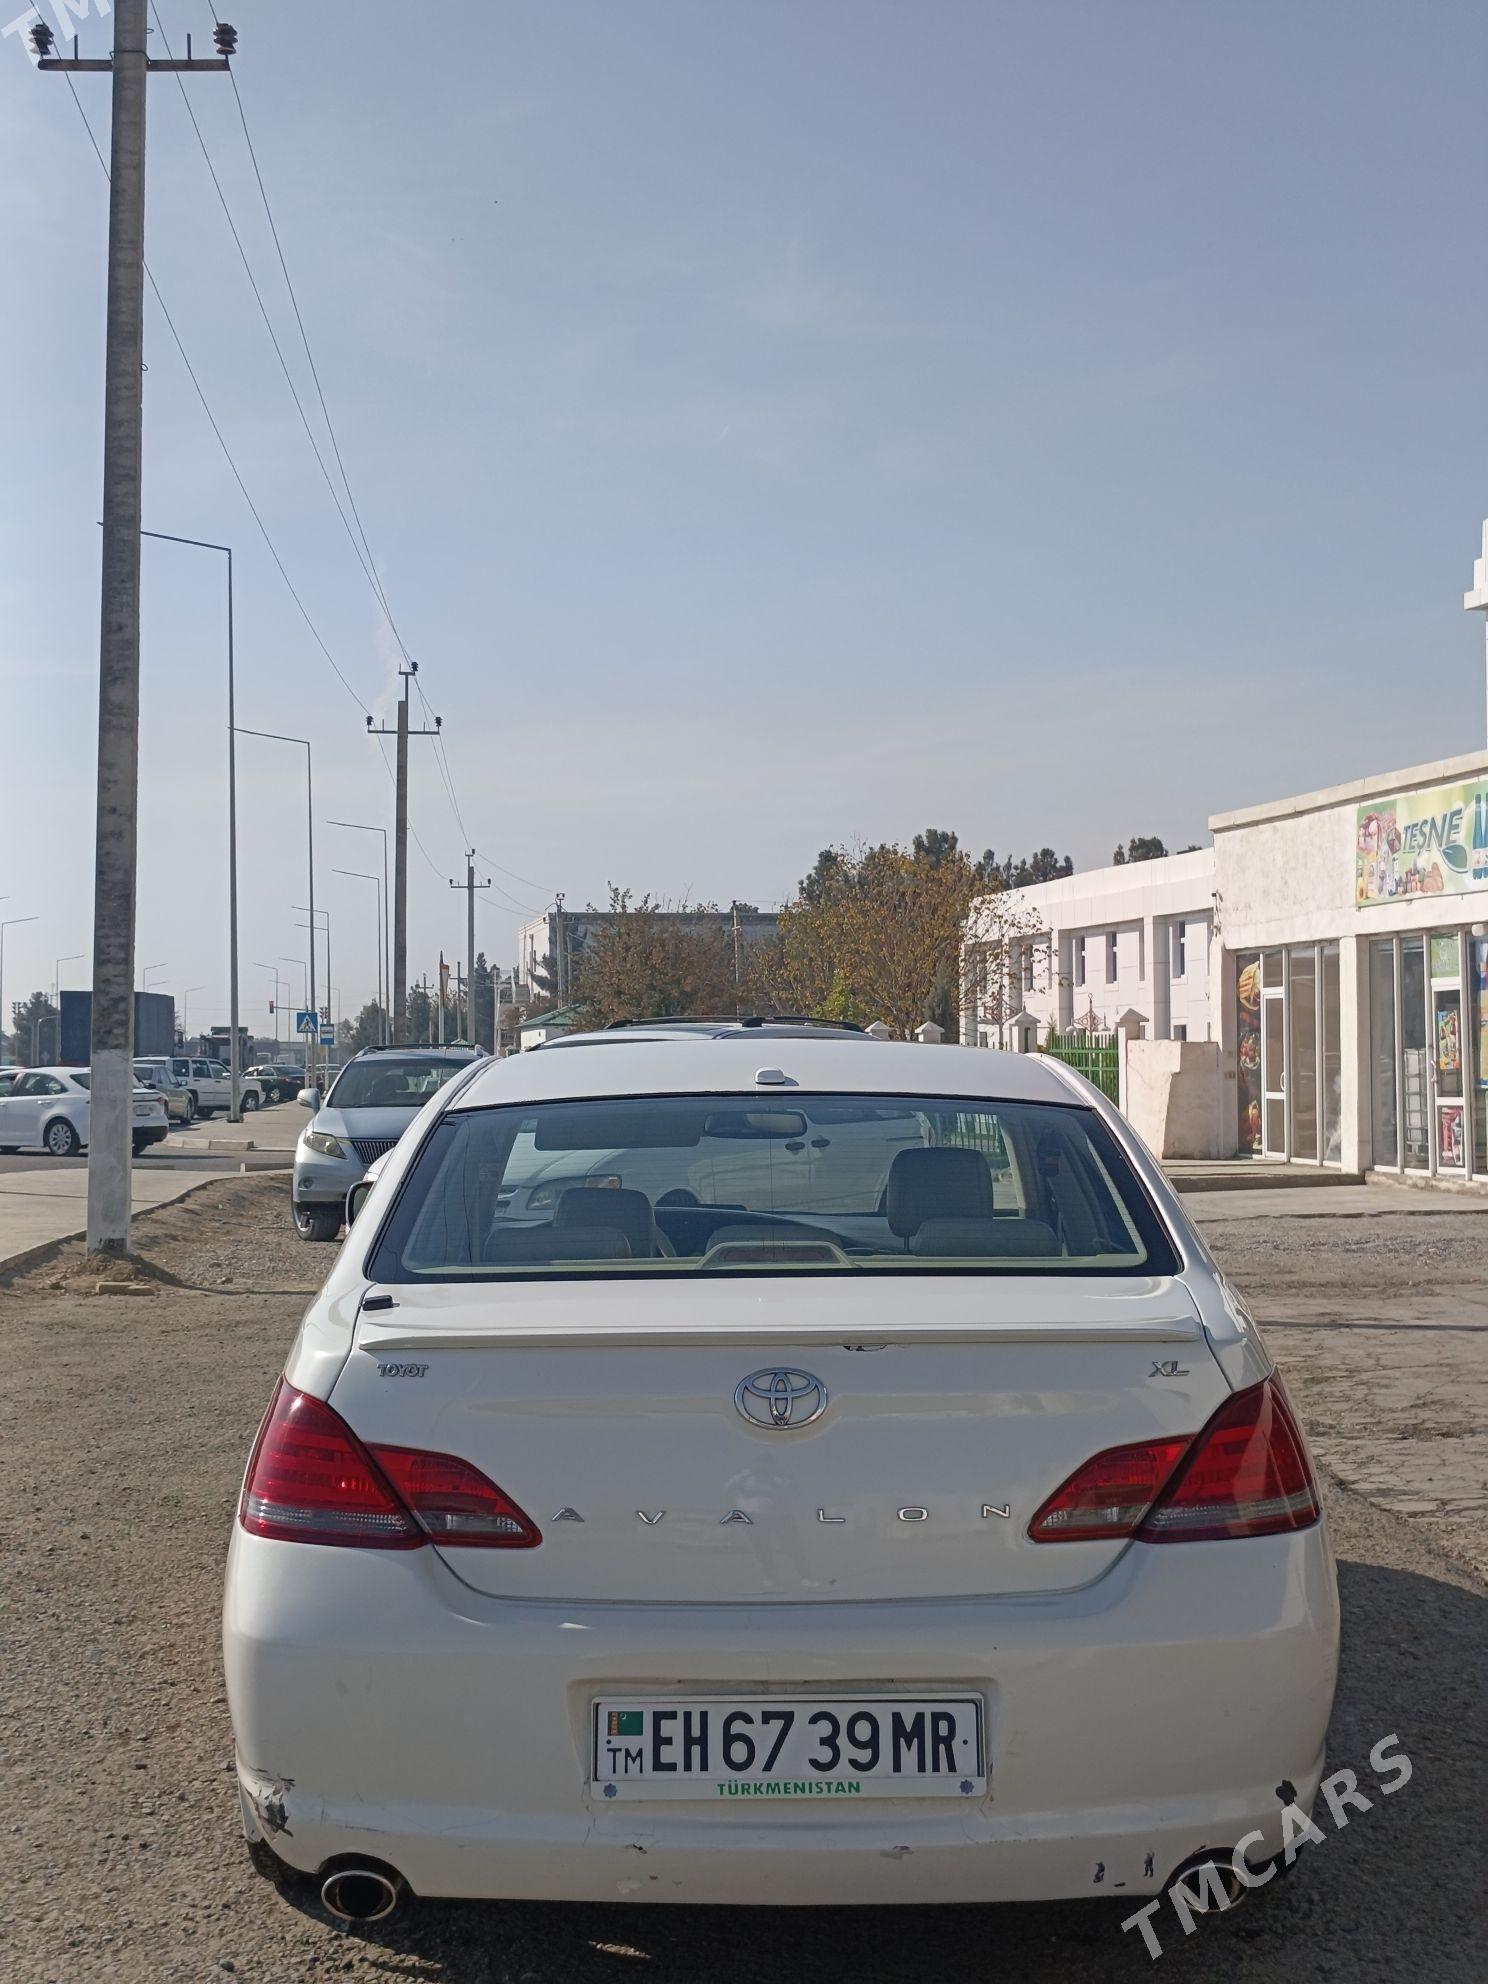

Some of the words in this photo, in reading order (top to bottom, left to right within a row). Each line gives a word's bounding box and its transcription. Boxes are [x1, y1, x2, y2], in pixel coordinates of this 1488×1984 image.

[377, 1363, 429, 1378] TOYOT
[552, 1503, 1011, 1525] AVALON
[606, 1748, 643, 1774] TM
[717, 1779, 861, 1797] TÜRKMENISTAN
